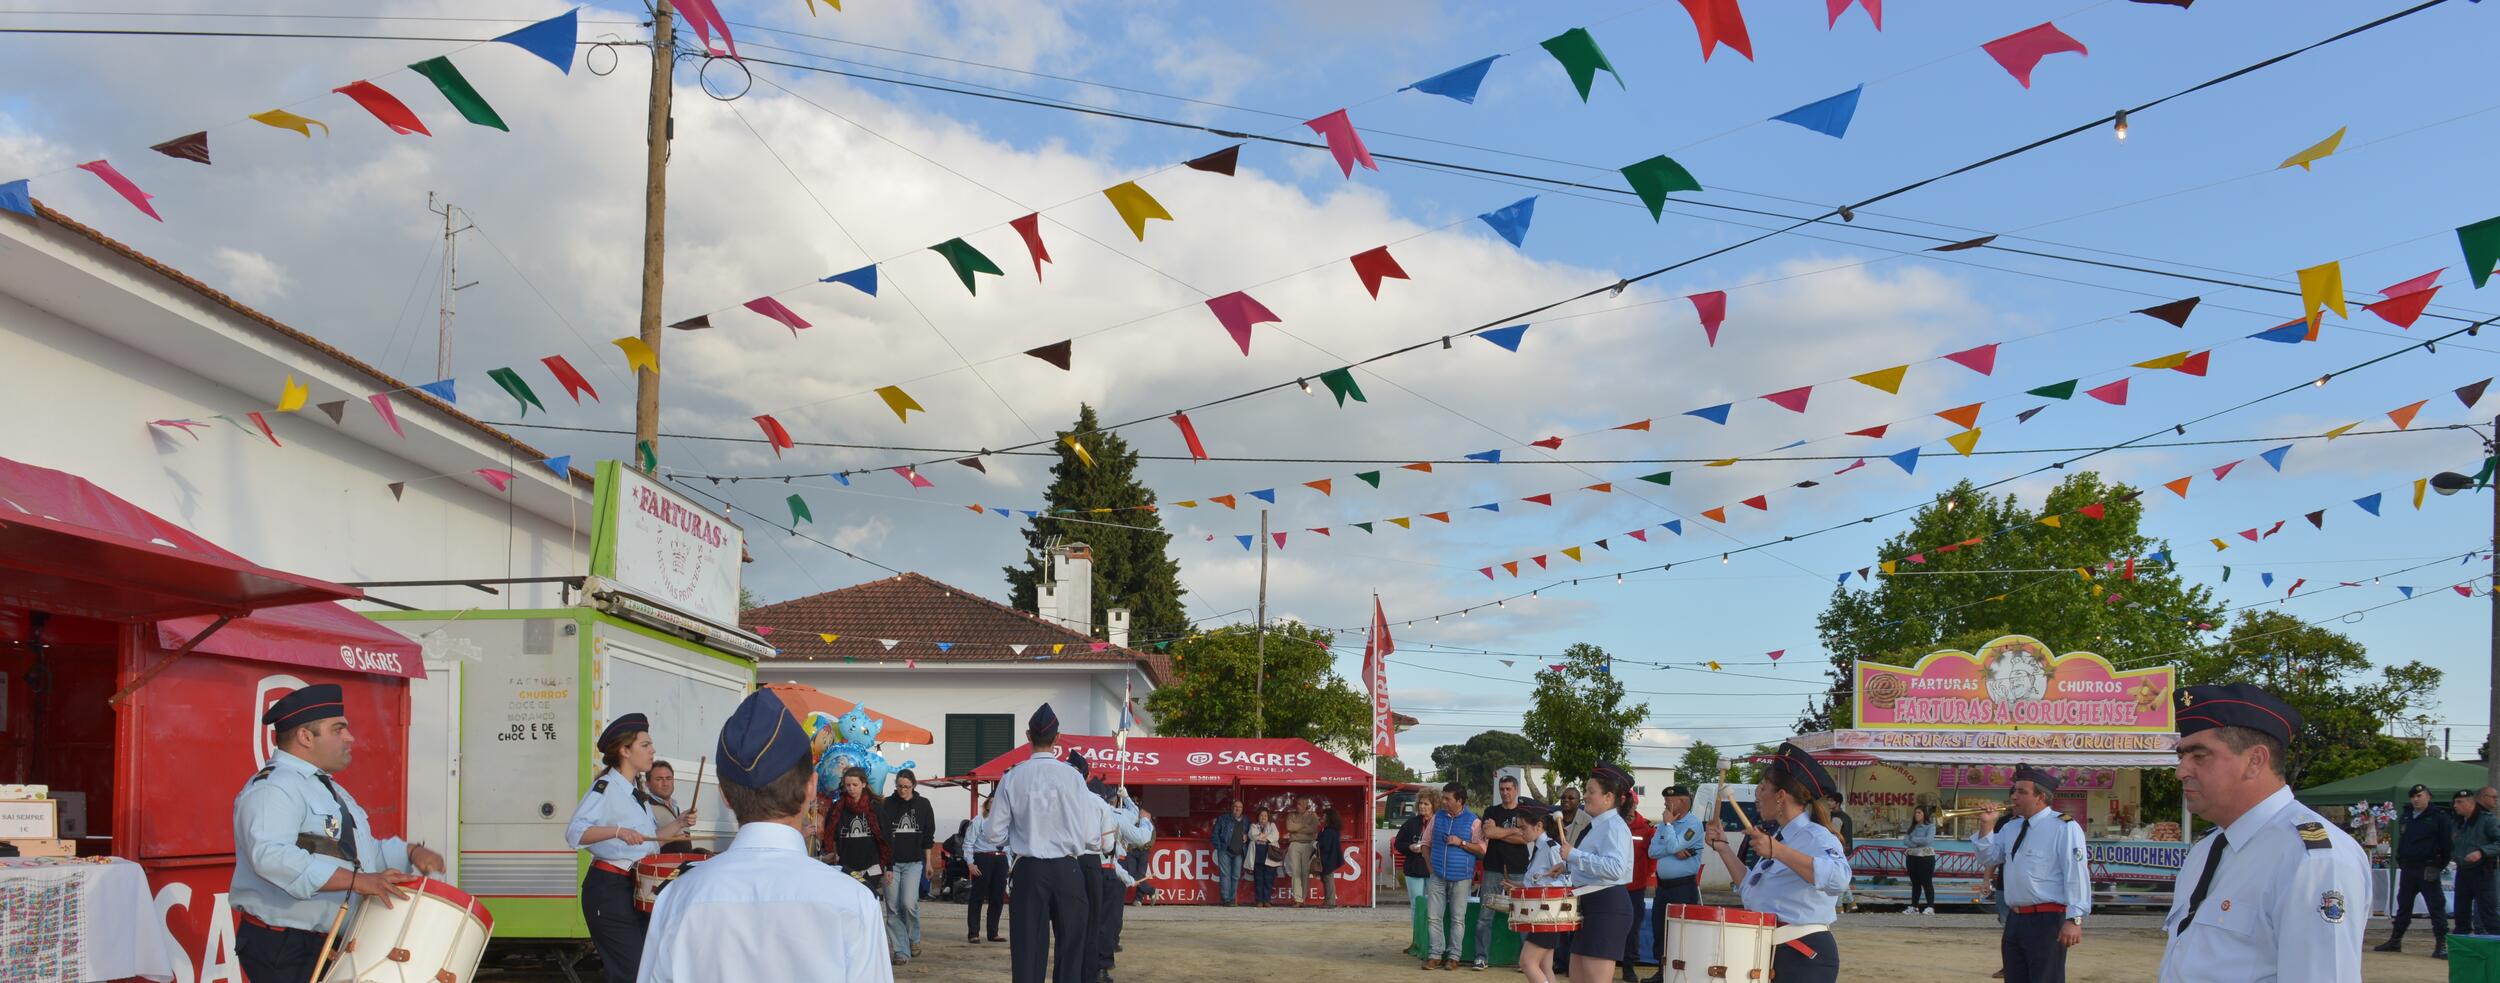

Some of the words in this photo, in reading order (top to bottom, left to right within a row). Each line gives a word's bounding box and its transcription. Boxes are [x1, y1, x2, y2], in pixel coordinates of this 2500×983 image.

[640, 486, 721, 548] FARTURAS
[356, 647, 402, 673] SAGRES
[1911, 679, 1978, 690] FARTURAS
[2058, 680, 2122, 692] CHURROS
[519, 690, 568, 698] CHURROS
[1895, 698, 1992, 725] FARTURAS
[1996, 700, 2011, 724] A
[2013, 699, 2137, 725] CORUCHENSE
[542, 723, 554, 731] DE
[1884, 734, 1963, 749] FARTURAS
[1964, 735, 1973, 748] E
[1977, 734, 2047, 749] CHURROS
[2052, 735, 2063, 748] A
[2064, 735, 2161, 750] CORUCHENSE
[1217, 750, 1311, 766] SAGRES
[1236, 764, 1293, 772] CERVEJA
[2106, 846, 2188, 867] CORUCHENSE
